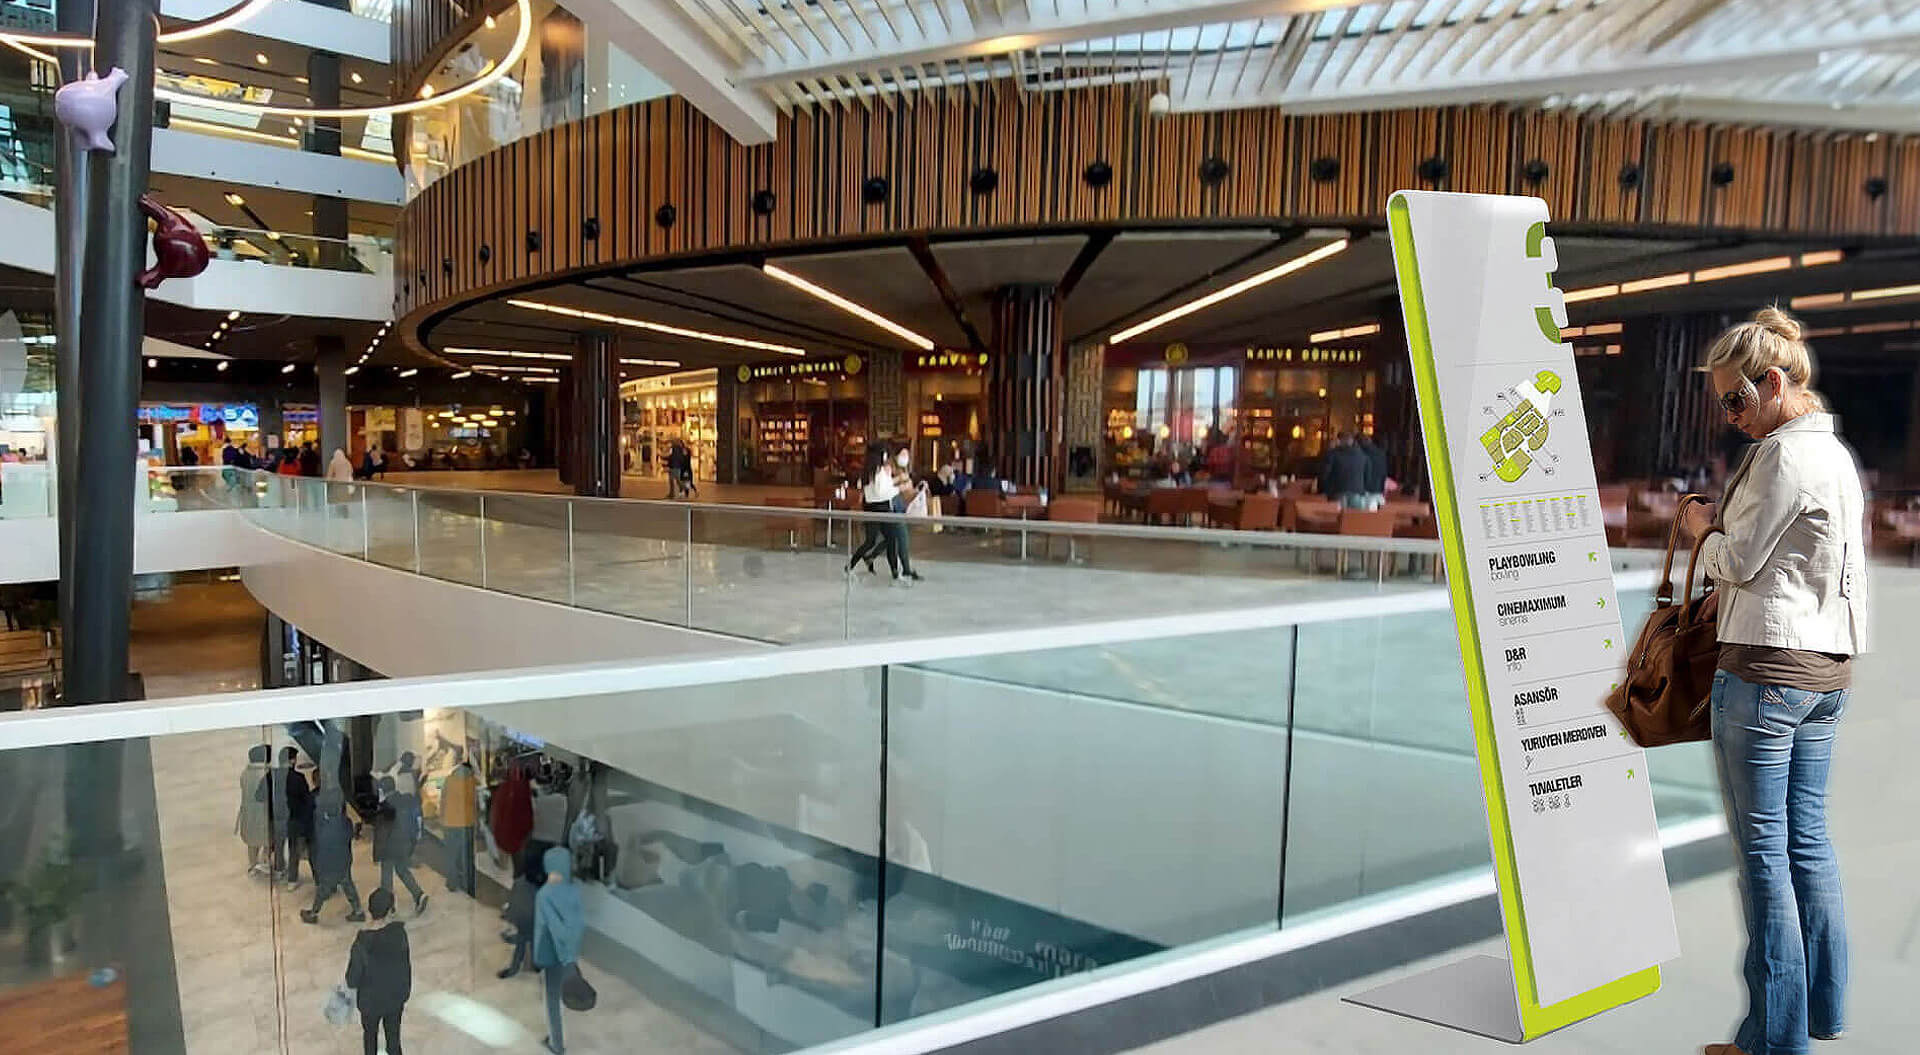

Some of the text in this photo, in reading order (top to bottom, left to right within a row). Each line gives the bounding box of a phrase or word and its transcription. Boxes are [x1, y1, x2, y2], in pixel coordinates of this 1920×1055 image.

[1489, 551, 1556, 571] PLAYBOWLING
[1497, 595, 1567, 616] CINEMAXIMUM
[1504, 647, 1527, 662] D&R
[1514, 686, 1559, 707] ASANSÖR
[1529, 775, 1583, 797] TUVALETLER
